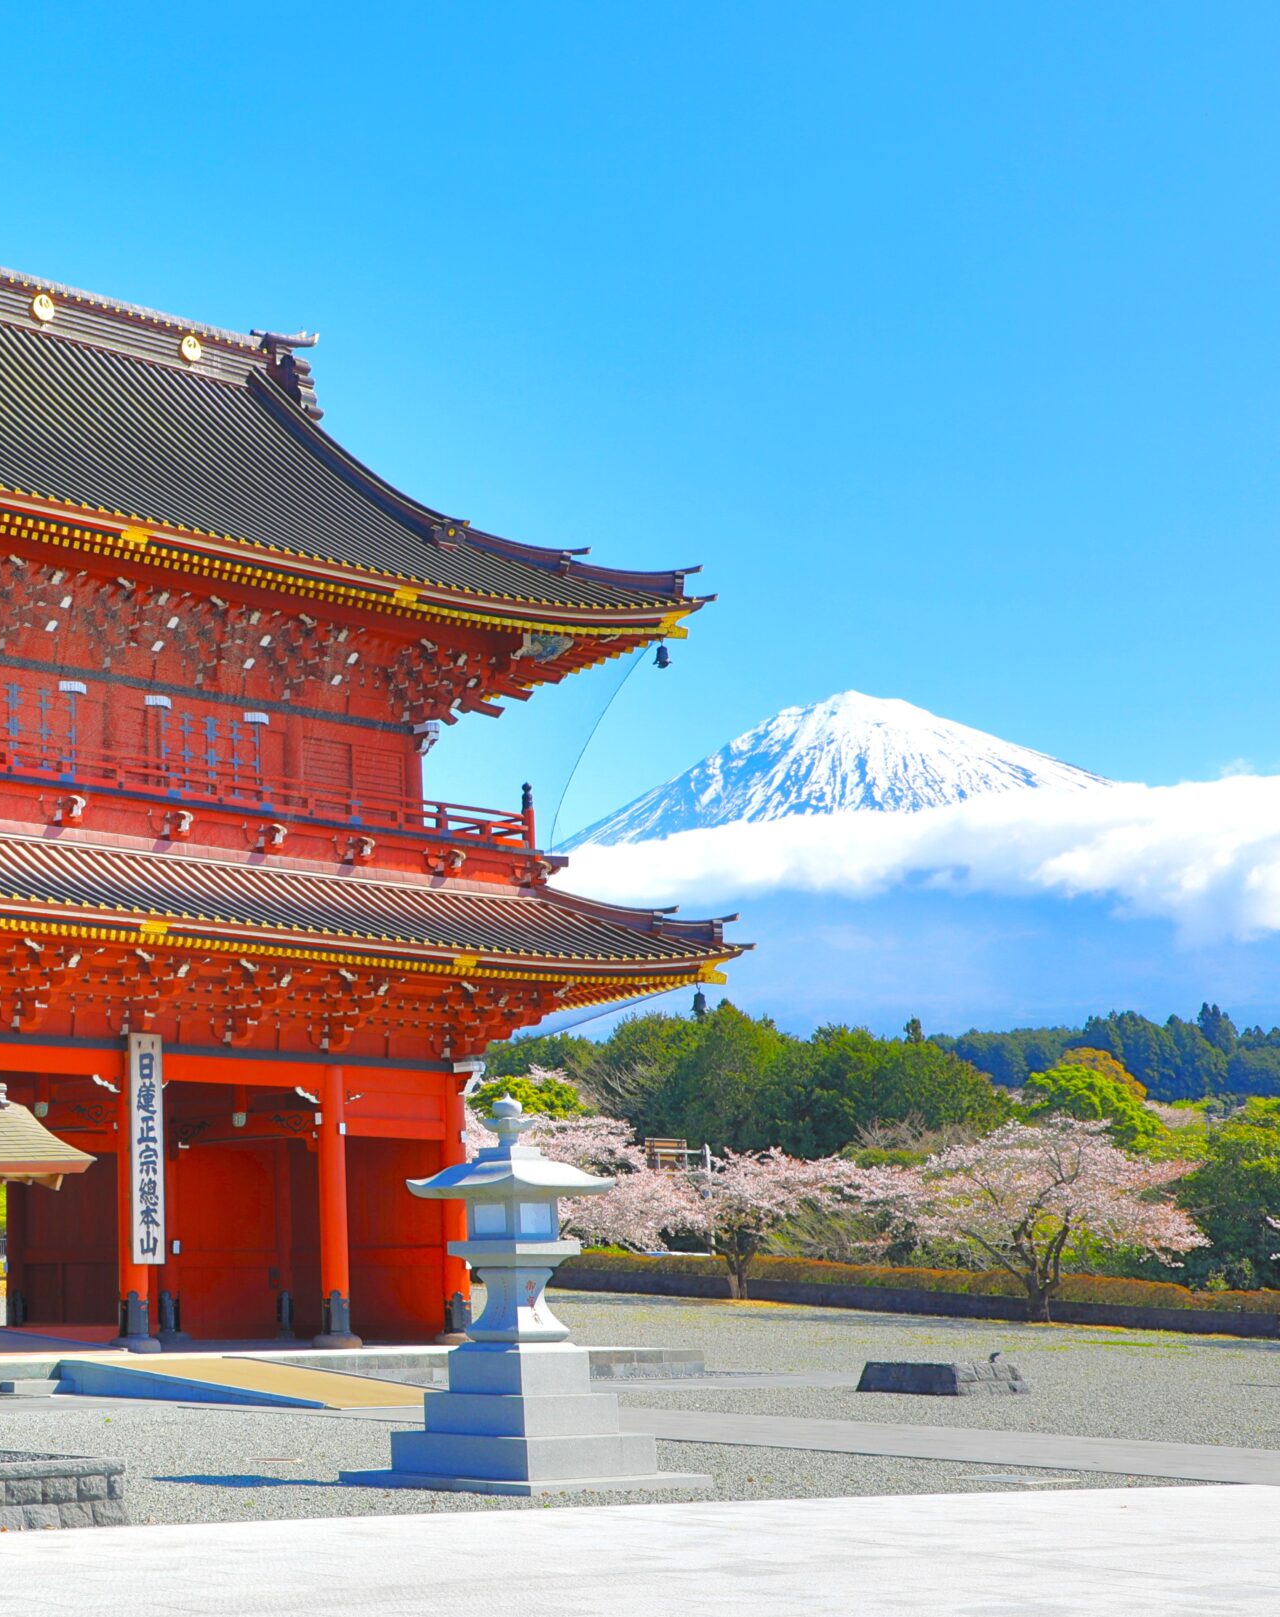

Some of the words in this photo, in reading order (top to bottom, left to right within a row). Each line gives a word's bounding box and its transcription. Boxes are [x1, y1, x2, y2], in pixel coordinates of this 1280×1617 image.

[137, 1053, 160, 1257] 日蓮正宗總本山
